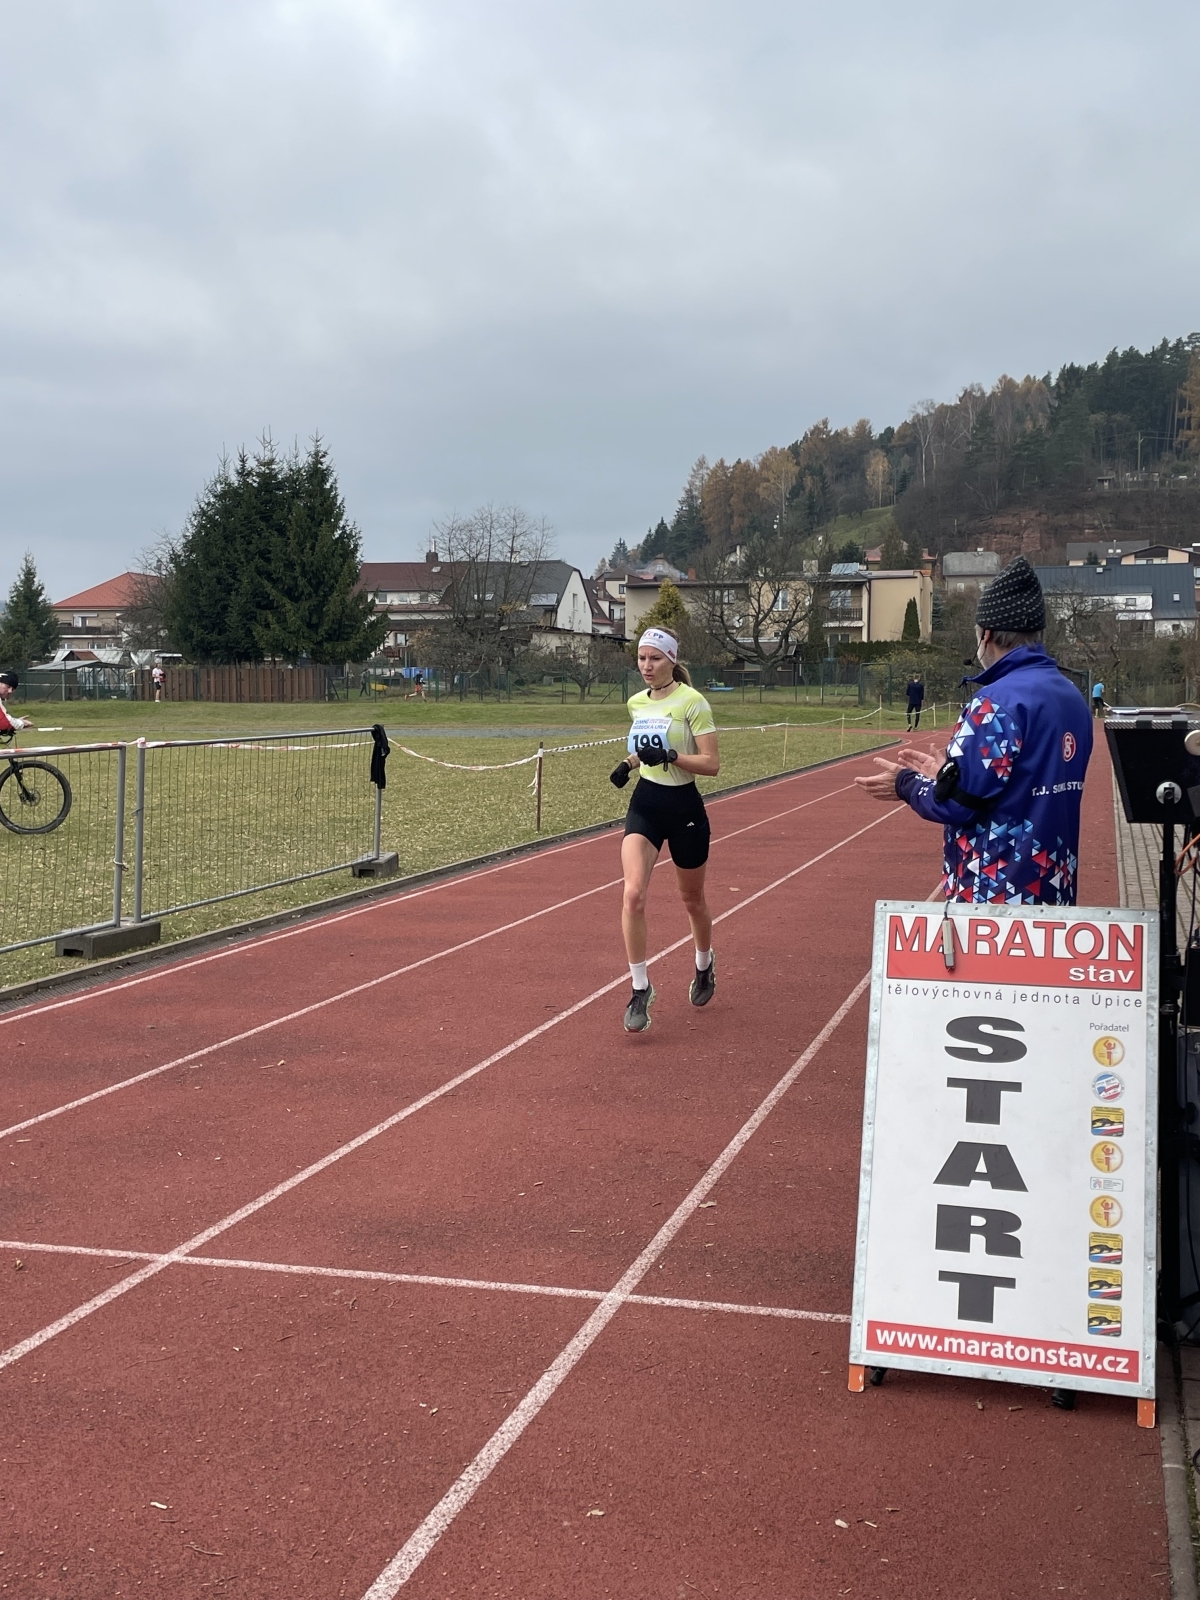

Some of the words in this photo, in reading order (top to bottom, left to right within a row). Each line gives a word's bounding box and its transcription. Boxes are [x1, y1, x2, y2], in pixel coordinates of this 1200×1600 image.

[633, 734, 664, 752] 199
[889, 914, 1144, 962] MARATON
[1068, 965, 1135, 984] stav
[887, 983, 1003, 1001] tělovýchovná
[1012, 990, 1081, 1005] jednota
[1090, 992, 1143, 1009] Úpice
[932, 1015, 1029, 1324] START
[875, 1328, 1130, 1374] www.maratonstav.cz
